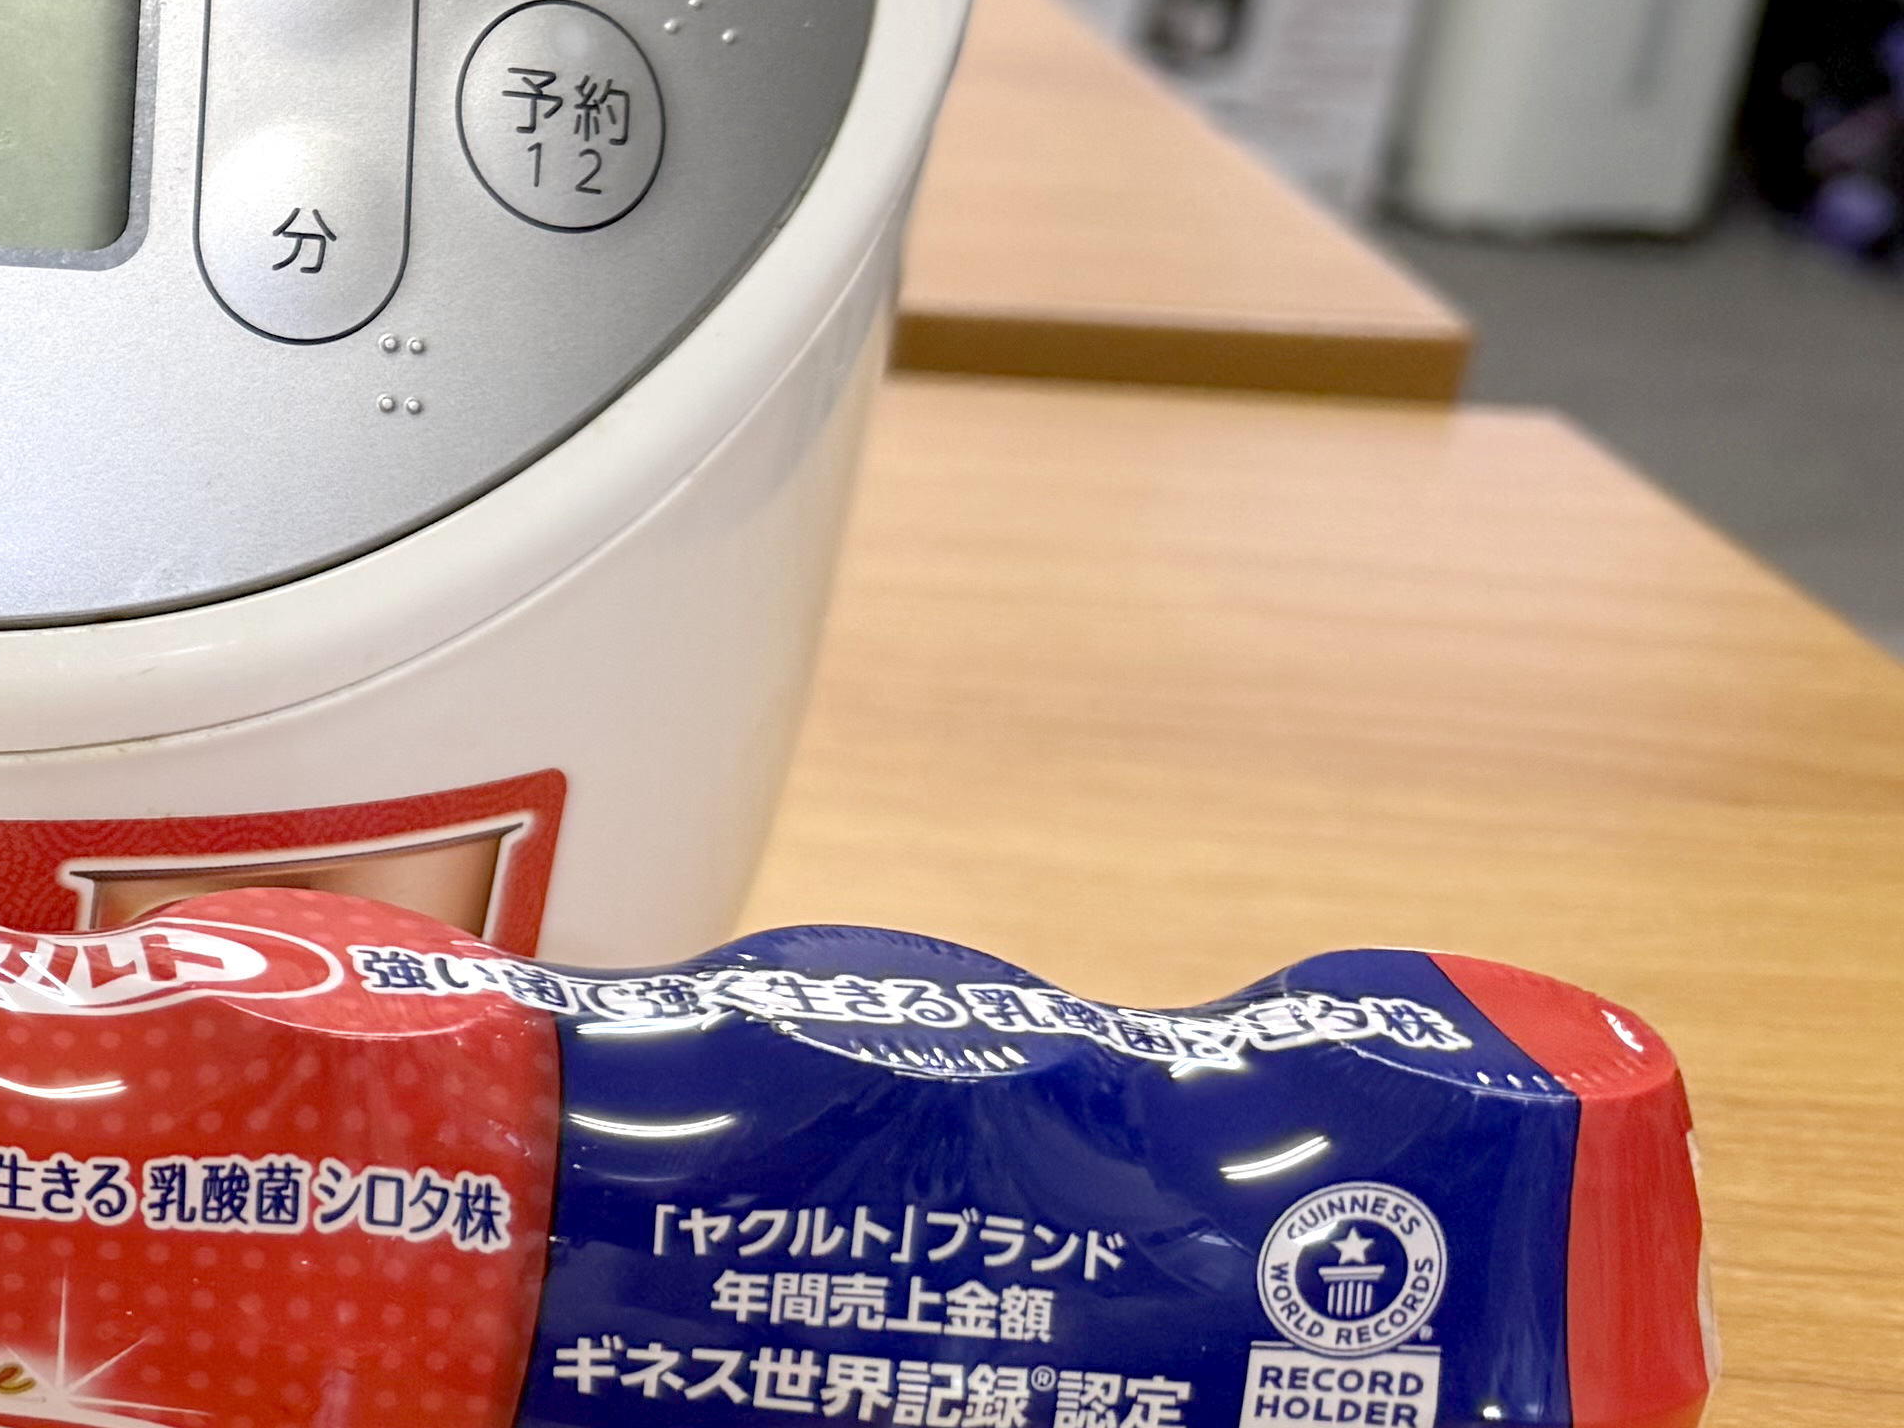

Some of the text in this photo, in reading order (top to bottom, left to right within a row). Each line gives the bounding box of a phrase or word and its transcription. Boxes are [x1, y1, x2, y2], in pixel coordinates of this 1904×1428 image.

[502, 66, 632, 146] 予約
[273, 207, 337, 274] 分
[653, 1203, 1129, 1281] 「ヤクルト」ブランド
[1286, 1193, 1422, 1241] GUINNESS
[710, 1269, 1056, 1345] 年間売上金額
[1270, 1256, 1435, 1346] WORLD RECORDS
[1258, 1364, 1424, 1397] RECORD
